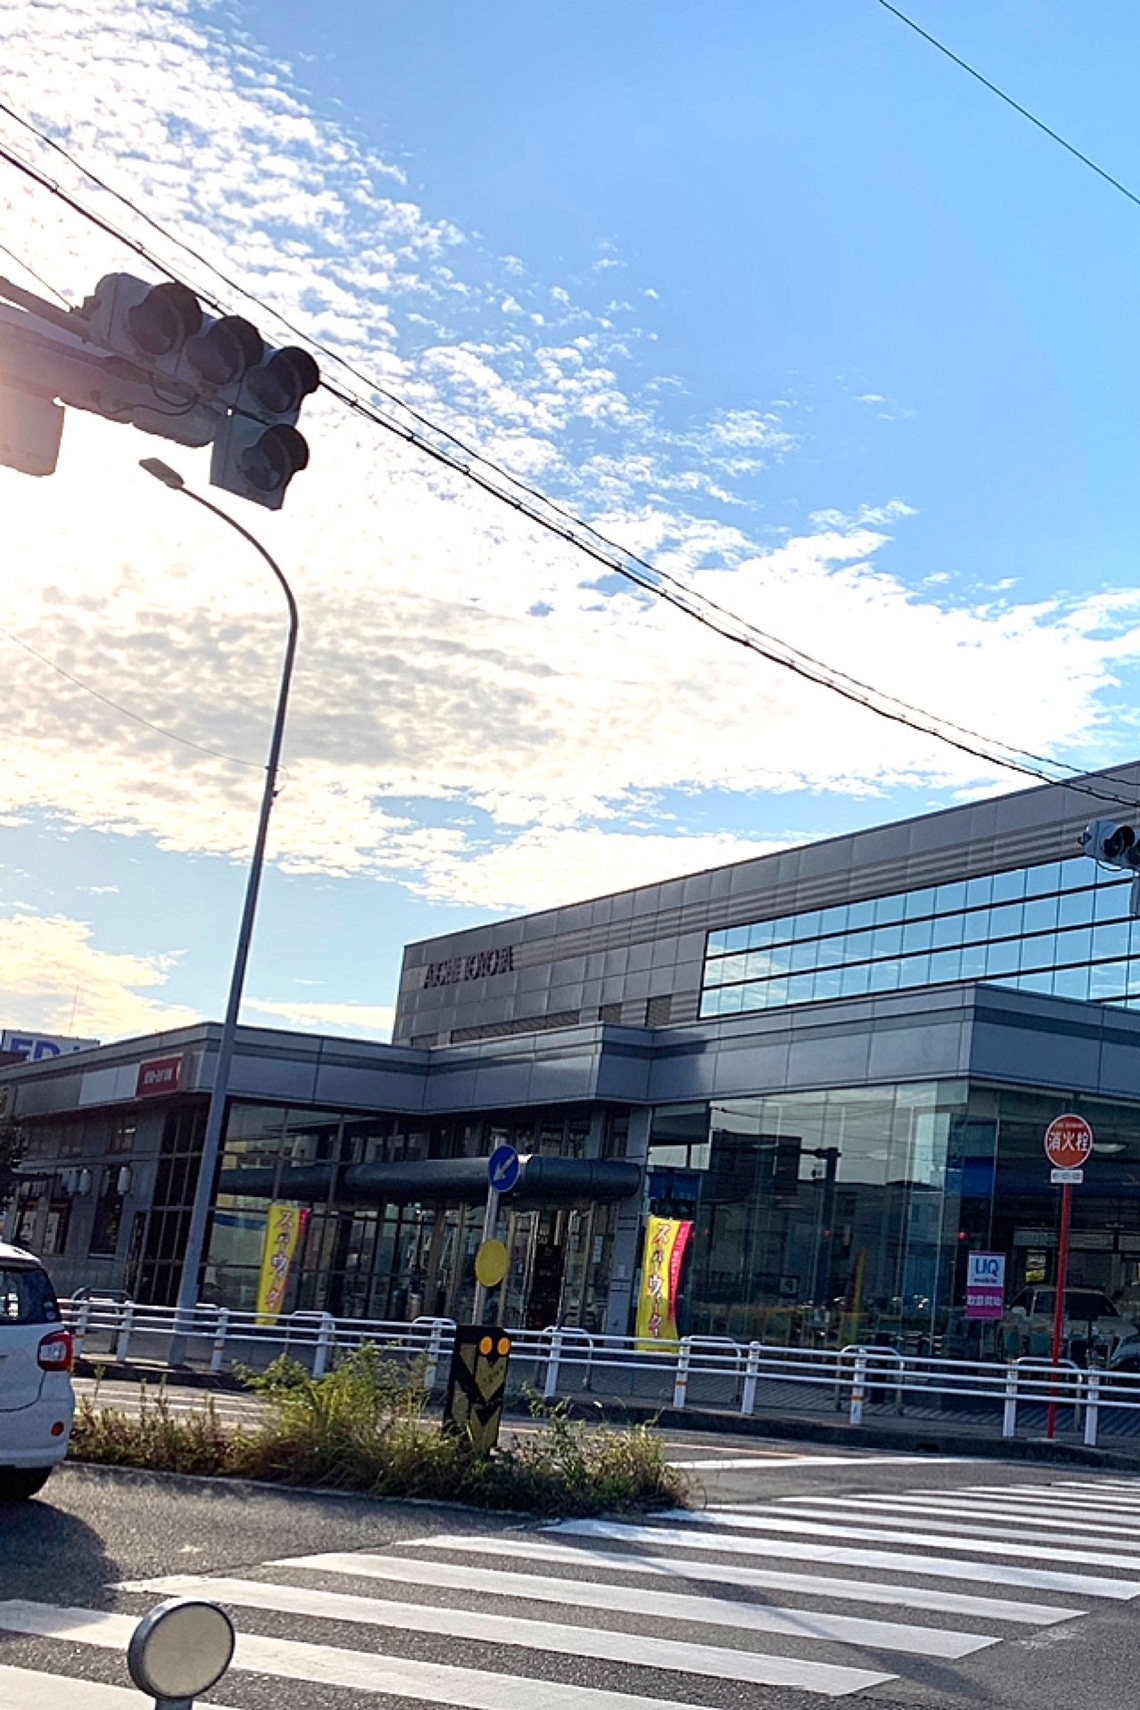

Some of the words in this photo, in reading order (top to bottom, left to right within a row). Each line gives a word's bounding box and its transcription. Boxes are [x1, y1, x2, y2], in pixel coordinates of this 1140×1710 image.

[1048, 1131, 1089, 1152] 消火栓
[975, 1258, 999, 1277] UQ
